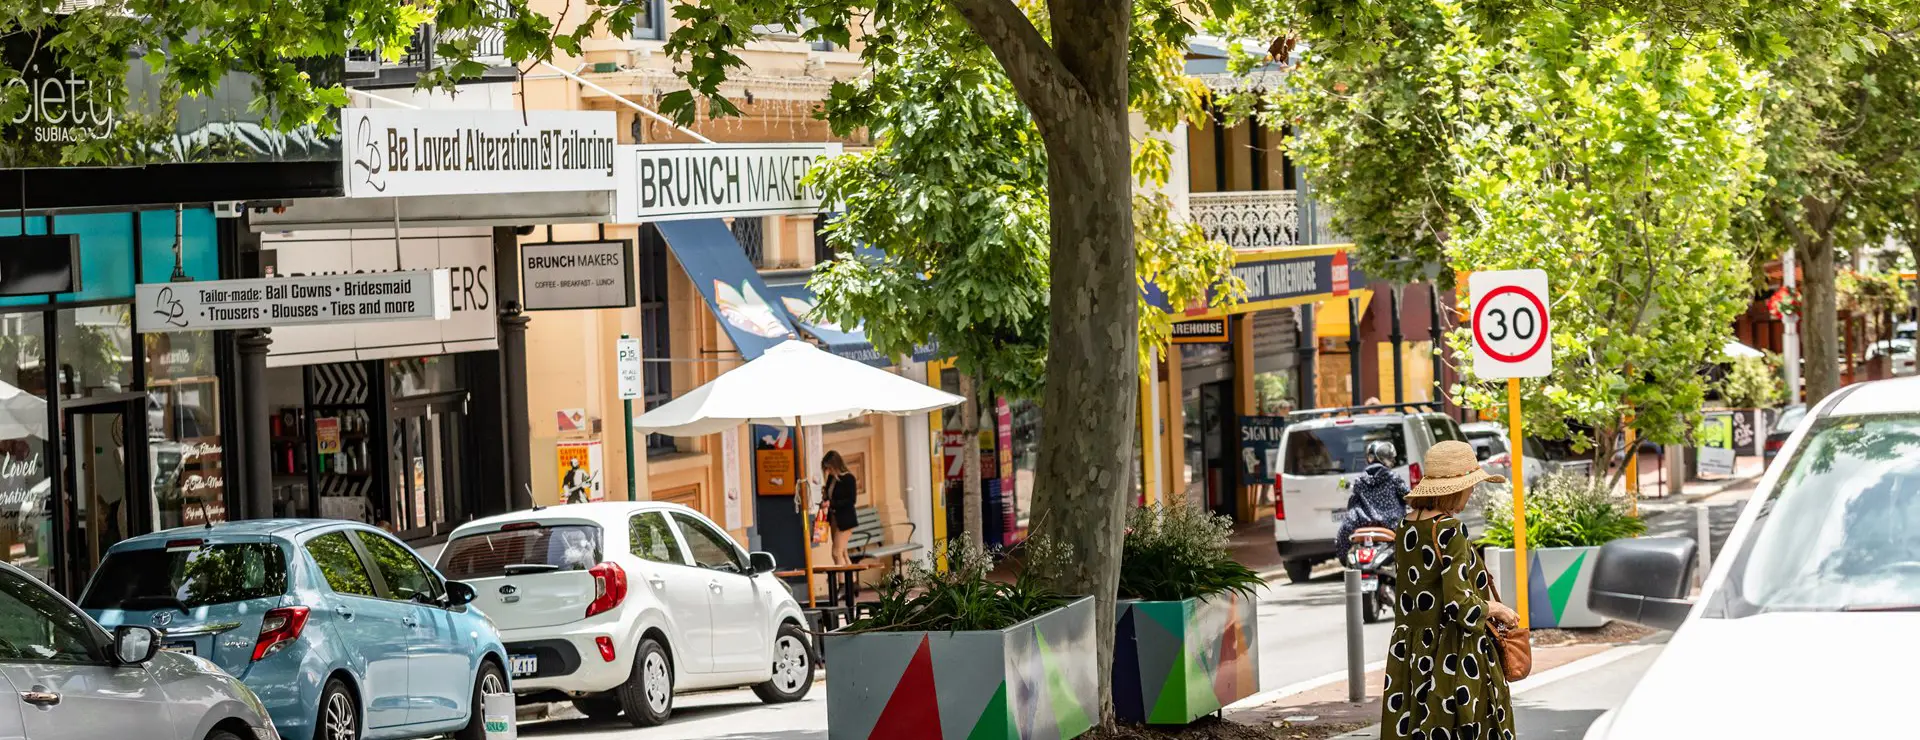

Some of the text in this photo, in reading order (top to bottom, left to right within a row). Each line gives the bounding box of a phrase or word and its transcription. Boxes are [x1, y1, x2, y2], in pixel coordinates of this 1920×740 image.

[387, 128, 409, 172] Be
[413, 128, 461, 171] Loved
[465, 128, 538, 171] Alteration
[553, 129, 614, 177] Tailoring
[641, 156, 740, 208] BRUNCH
[528, 253, 619, 269] BRUNCH MAKERS
[535, 281, 556, 289] COFFEE
[560, 280, 591, 288] BREAKFAST
[1267, 260, 1317, 296] WAREHOUSE
[199, 279, 412, 303] Tailor-made: Ball Gowns Bridesmaid
[208, 299, 415, 321] Trousers Blouses Ties and more
[1172, 322, 1222, 335] AREHOUSE
[1487, 307, 1534, 342] 30
[944, 434, 963, 445] OPE
[1241, 426, 1266, 441] SIGN
[2, 451, 39, 480] Loved
